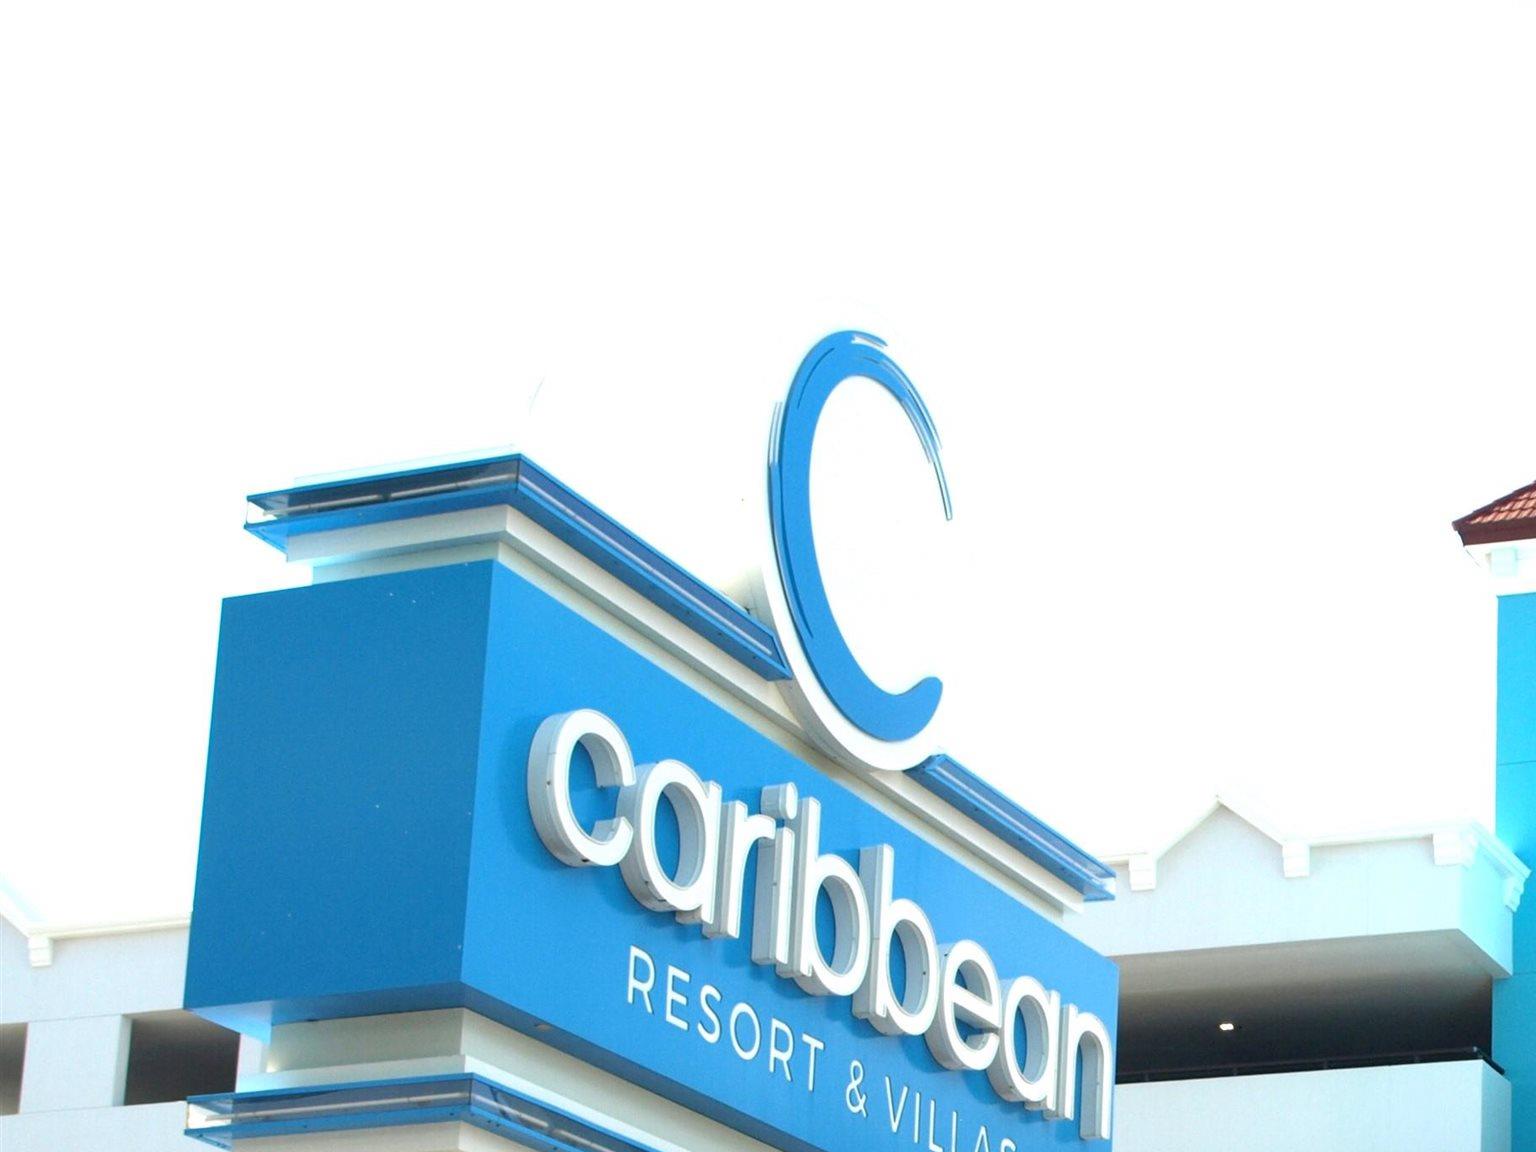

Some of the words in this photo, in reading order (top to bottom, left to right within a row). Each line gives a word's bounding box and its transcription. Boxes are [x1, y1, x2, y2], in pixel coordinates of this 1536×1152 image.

[527, 709, 1111, 1140] caribbean
[626, 944, 825, 1092] RESORT
[844, 1060, 868, 1119] &
